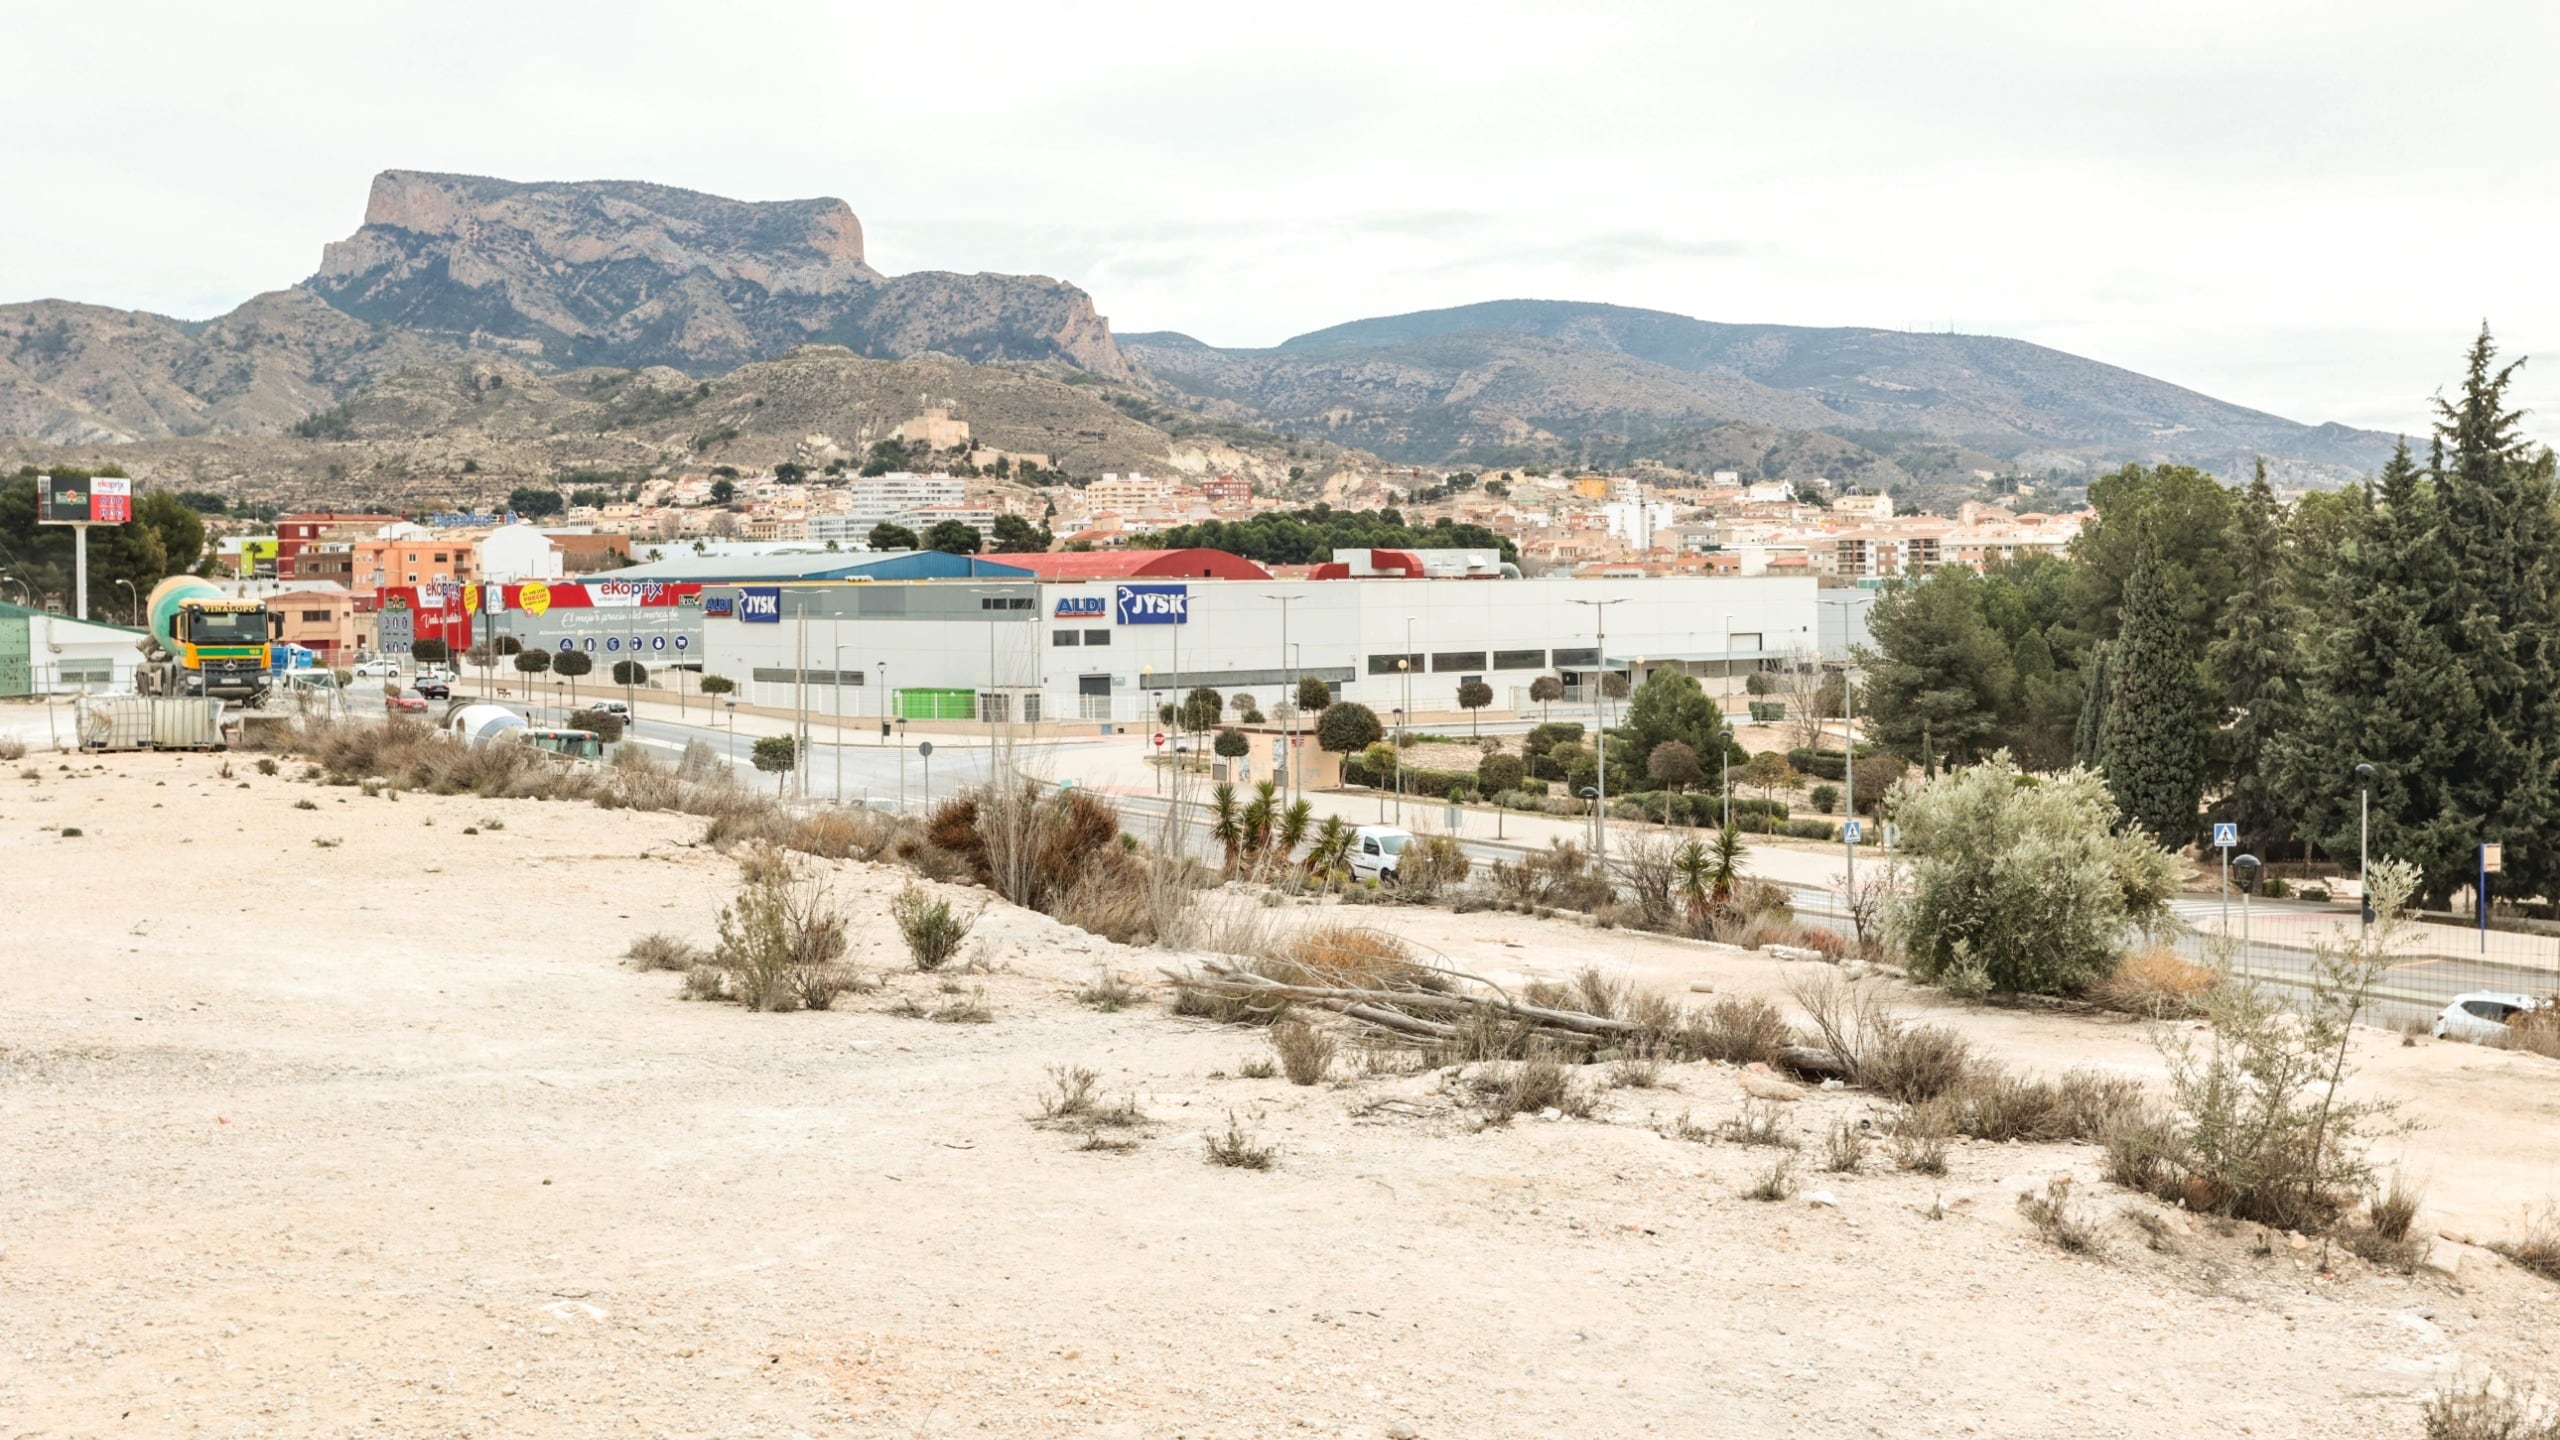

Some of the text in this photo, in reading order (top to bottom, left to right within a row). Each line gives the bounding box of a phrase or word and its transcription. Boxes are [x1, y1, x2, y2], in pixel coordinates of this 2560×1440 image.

[600, 579, 662, 601] ekoprix
[705, 597, 732, 612] ALDI
[746, 595, 777, 614] JYSK
[1055, 597, 1106, 613] ALDI
[1132, 594, 1186, 614] JYSK
